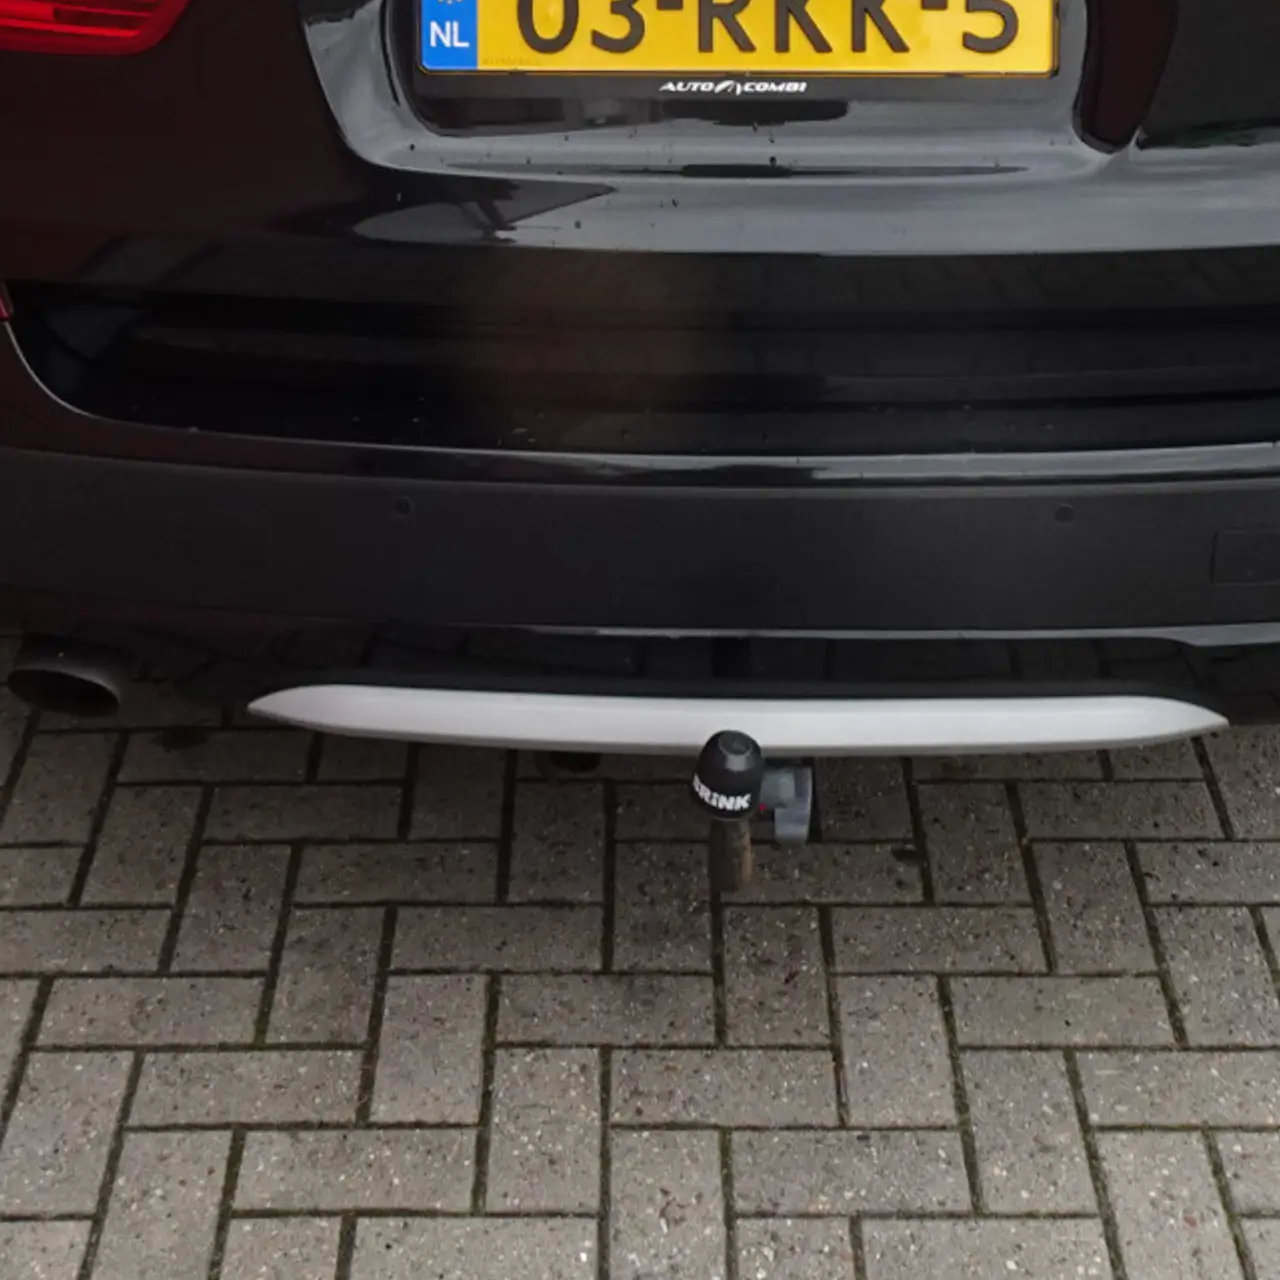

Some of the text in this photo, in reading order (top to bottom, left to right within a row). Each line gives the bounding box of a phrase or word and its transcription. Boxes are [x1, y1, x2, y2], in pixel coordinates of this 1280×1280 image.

[429, 20, 470, 48] NL
[658, 81, 808, 93] AUTO COMBI
